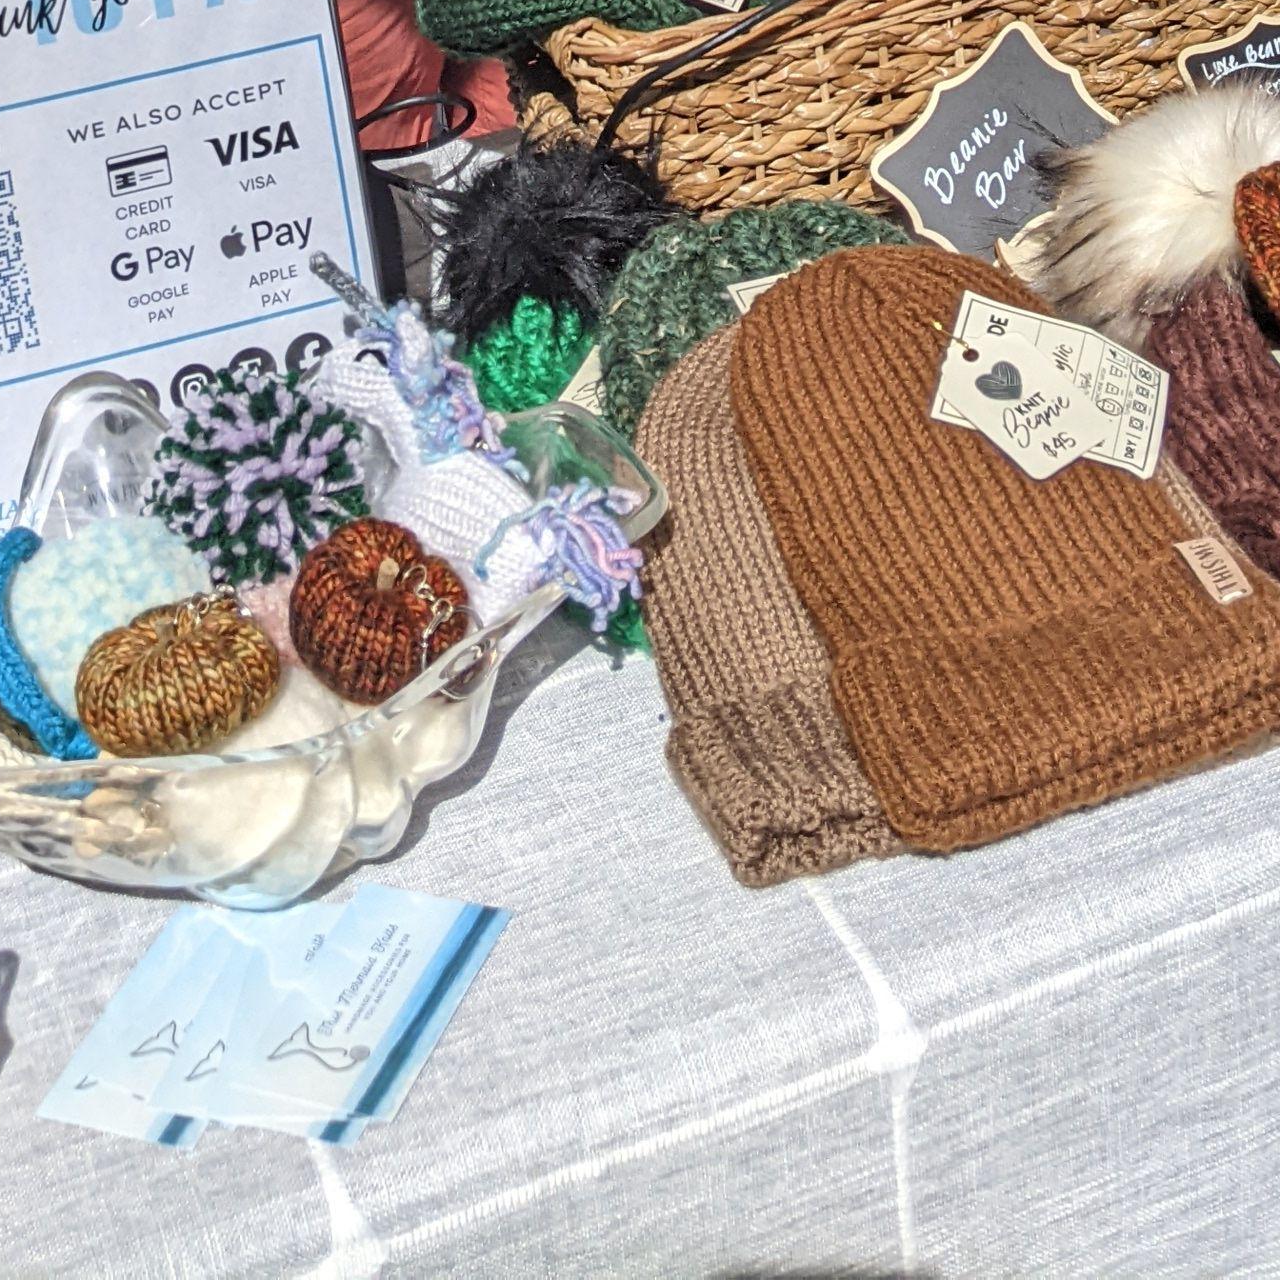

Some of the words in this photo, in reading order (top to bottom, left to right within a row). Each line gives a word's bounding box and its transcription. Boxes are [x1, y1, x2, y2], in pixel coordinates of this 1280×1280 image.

[67, 121, 106, 144] WE
[116, 104, 182, 134] ALSO
[192, 78, 287, 116] ACCEPT
[204, 120, 300, 168] VISA
[924, 108, 1008, 205] Beanie
[239, 173, 277, 192] VISA
[975, 139, 1026, 210] Bar
[115, 195, 174, 221] CREDIT
[125, 219, 172, 241] CARD
[251, 216, 313, 253] Pay
[146, 244, 196, 275] Pay
[248, 264, 299, 289] APPLE
[127, 283, 190, 309] GOOGLE
[261, 288, 293, 308] PAY
[148, 306, 176, 324] PAY
[1017, 391, 1044, 417] KNIT
[1002, 395, 1071, 449] Beanie
[1123, 440, 1136, 460] DRY
